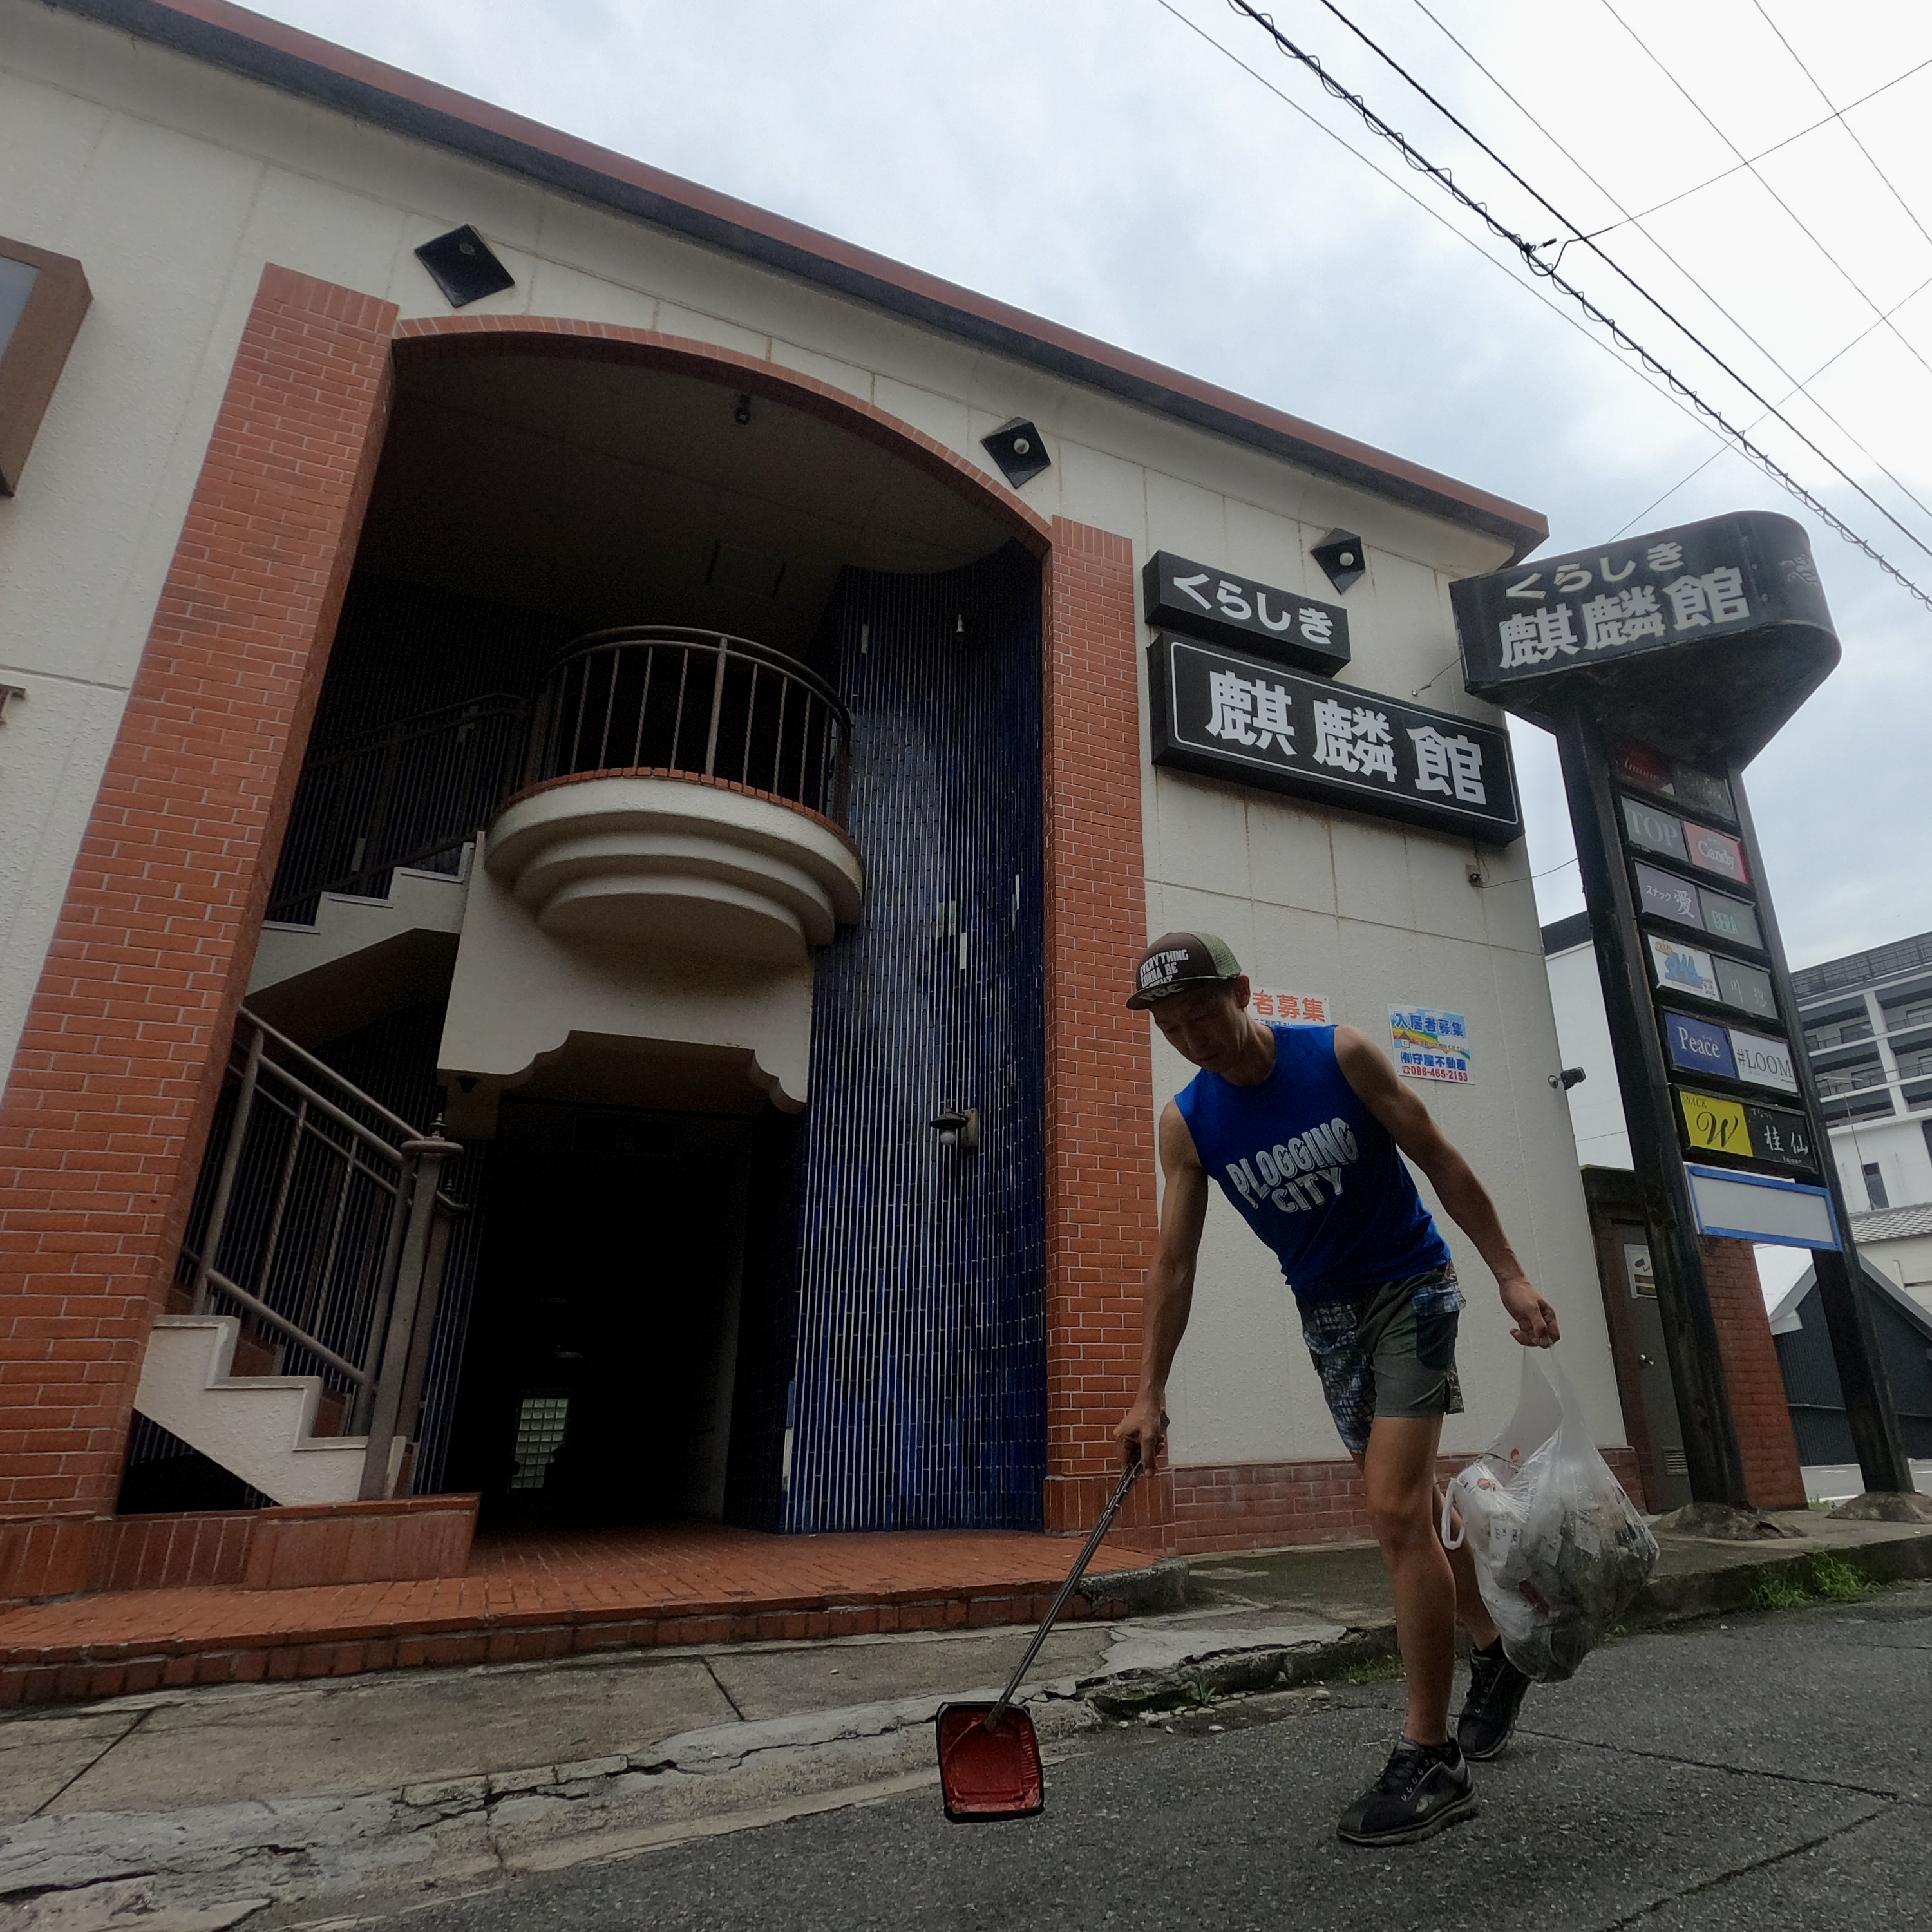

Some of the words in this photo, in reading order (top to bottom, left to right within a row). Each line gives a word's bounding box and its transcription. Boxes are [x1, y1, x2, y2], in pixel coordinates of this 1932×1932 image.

[1505, 542, 1684, 599] くらしき
[1173, 573, 1334, 644] くらしき
[1499, 566, 1750, 669] 麒麟館
[1206, 671, 1487, 806] 麒麟館
[1698, 840, 1735, 871] Candy
[1647, 885, 1672, 902] スナック
[1674, 889, 1695, 919] 愛
[1164, 962, 1179, 975] BE
[1252, 990, 1325, 1023] 者募集
[1394, 1012, 1464, 1038] 入居者募集
[1676, 1026, 1721, 1058] Peace
[1410, 1066, 1468, 1082] 086-465-2153
[1736, 1048, 1794, 1078] #LOOM
[1696, 1112, 1738, 1148] W
[1764, 1124, 1809, 1155] 桂仙
[1225, 1117, 1359, 1209] PLOGGING
[1271, 1166, 1343, 1213] CITY
